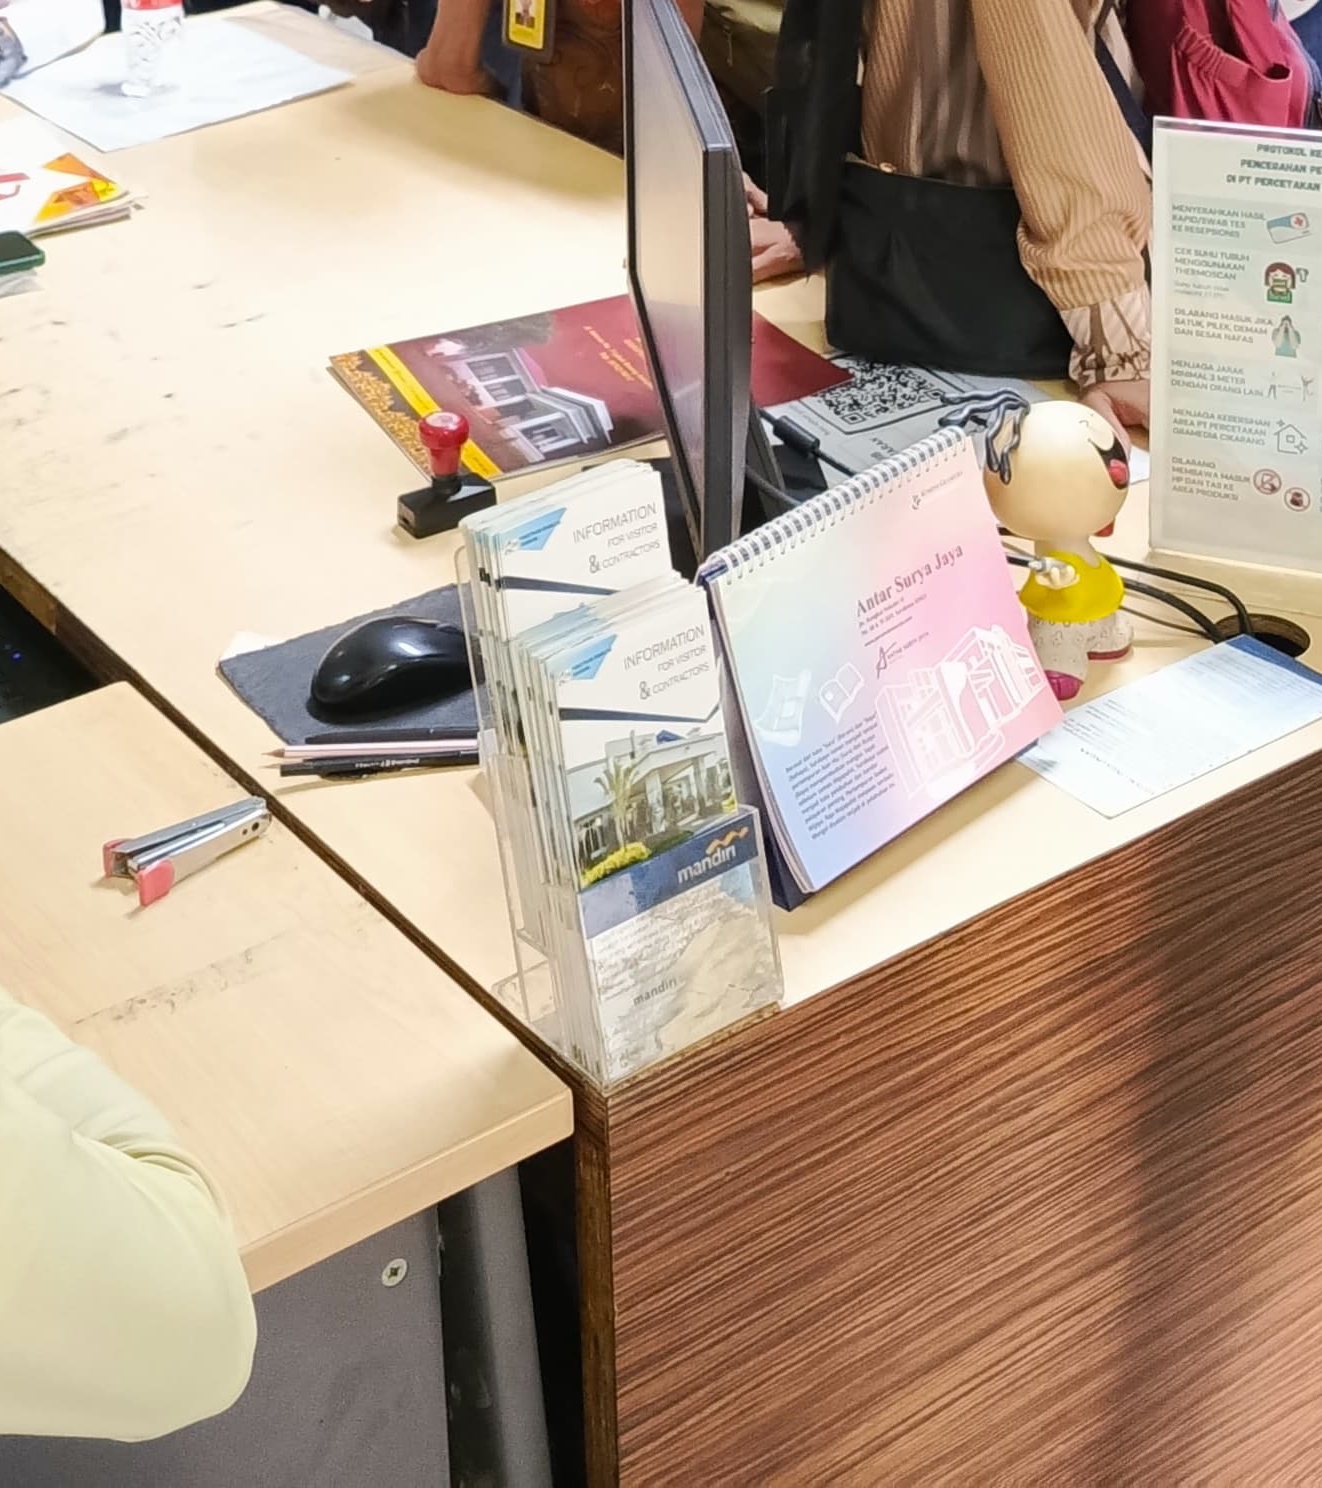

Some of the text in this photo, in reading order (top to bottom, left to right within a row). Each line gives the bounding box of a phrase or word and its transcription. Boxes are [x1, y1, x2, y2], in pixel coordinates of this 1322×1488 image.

[1257, 144, 1307, 156] PROTOKOL
[1226, 174, 1236, 183] DI
[1239, 176, 1251, 184] PT
[1255, 177, 1320, 192] PERCETAKAN
[573, 502, 657, 543] INFORMATION
[608, 523, 658, 547] FOR VISITOR
[589, 540, 660, 573] & CONTRACTORS
[858, 586, 892, 617] Antar
[894, 564, 932, 592] Surya
[935, 545, 963, 570] Jaya
[624, 624, 705, 671] INFORMATION
[658, 645, 706, 673] FOR VISITOR
[640, 662, 709, 700] & CONTRACTORS
[677, 844, 737, 883] mandiri
